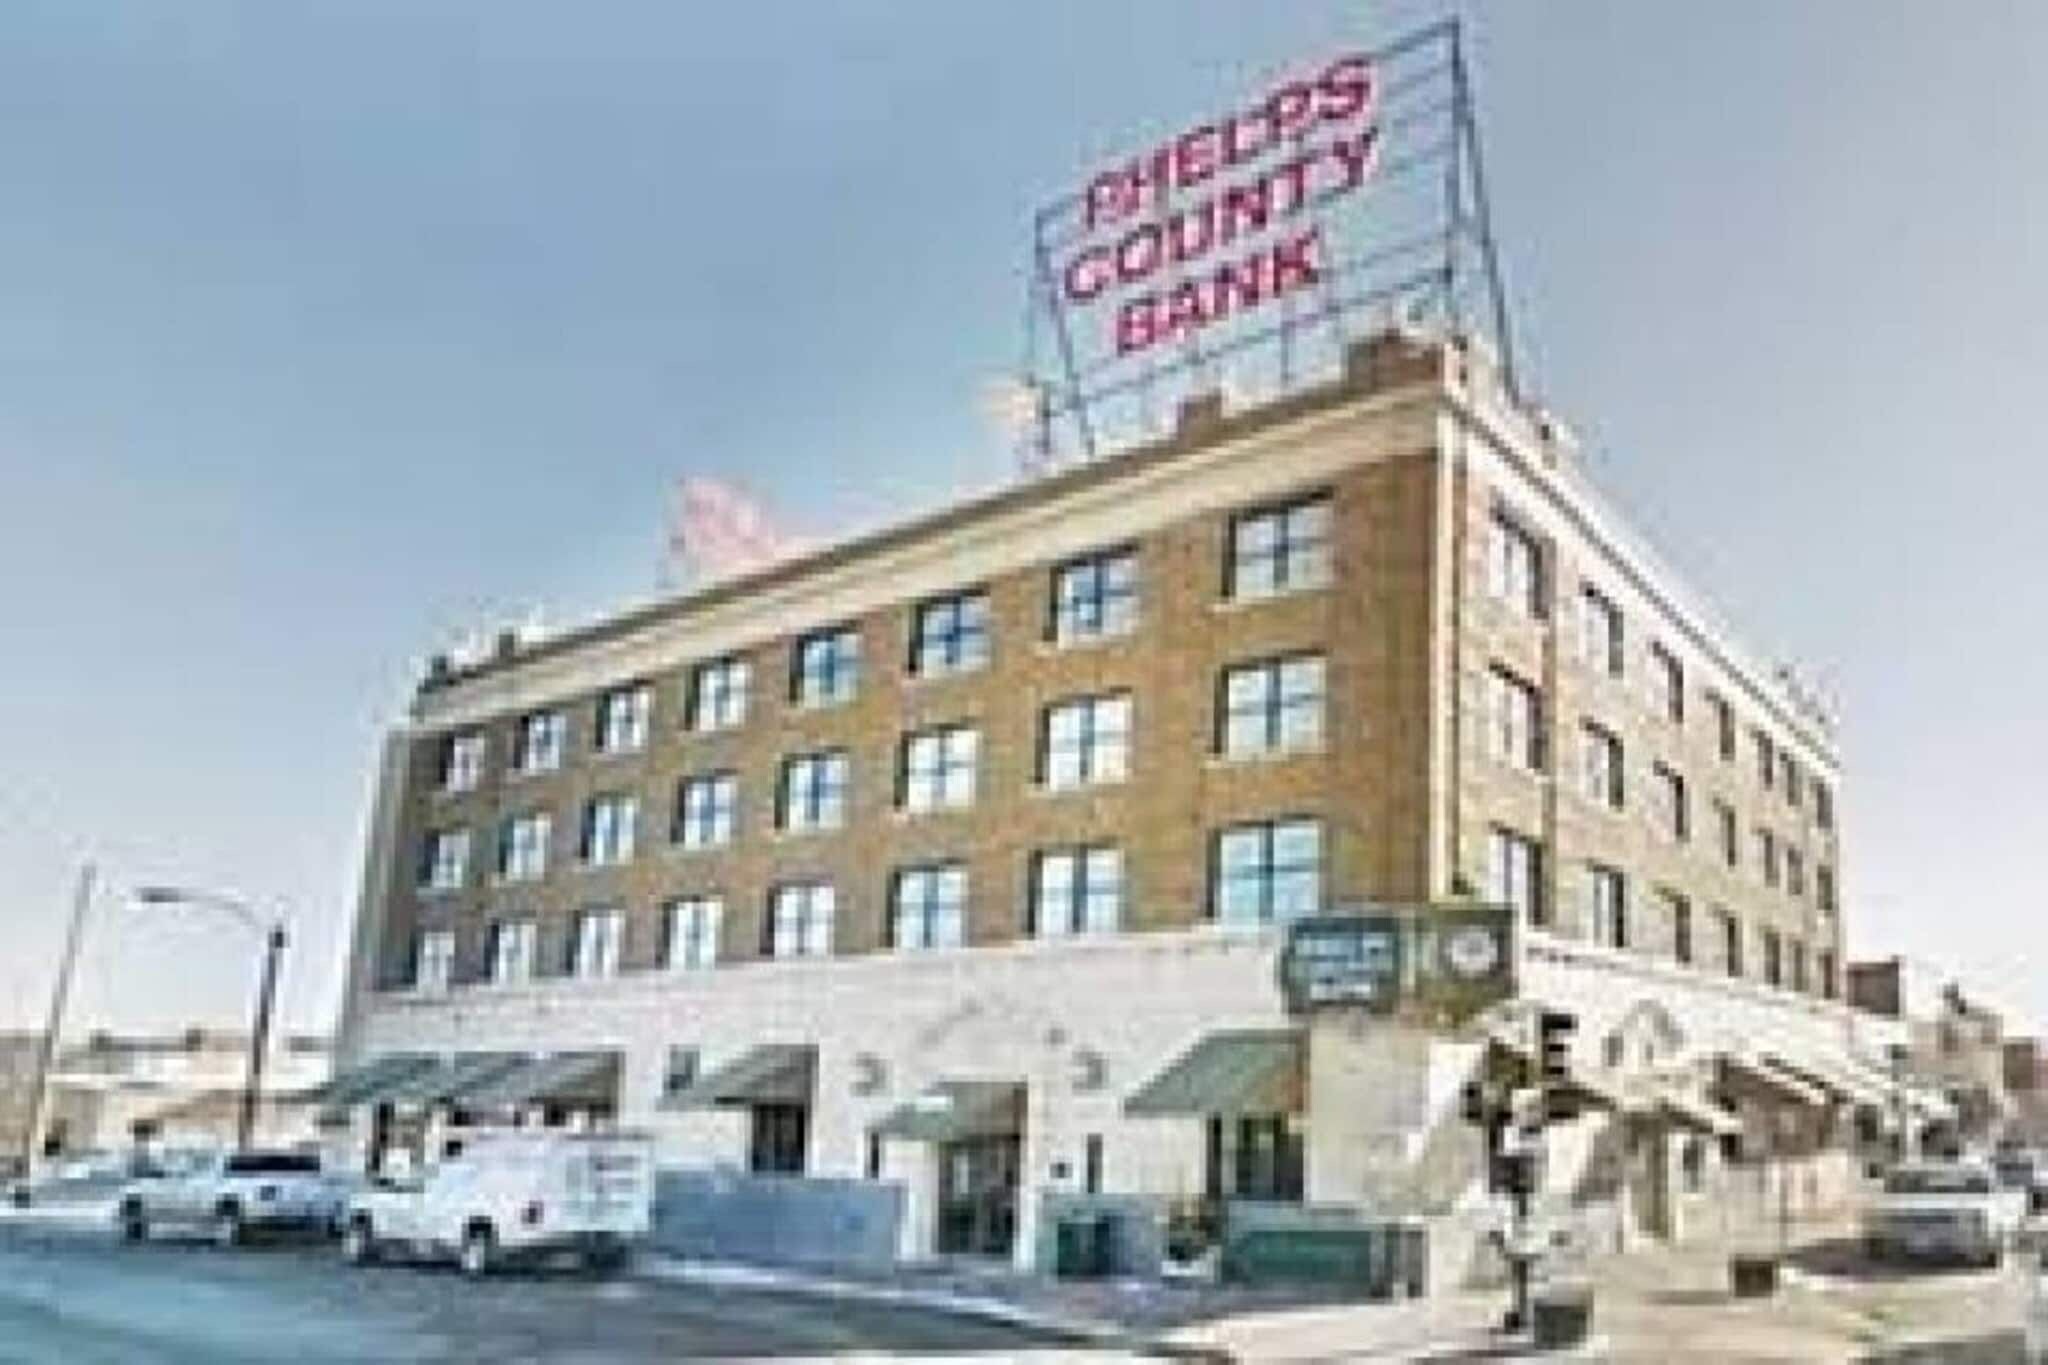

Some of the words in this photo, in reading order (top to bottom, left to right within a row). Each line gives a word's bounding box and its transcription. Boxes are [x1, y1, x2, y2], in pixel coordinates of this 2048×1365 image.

[1064, 125, 1379, 299] COUNTY
[1086, 57, 1373, 231] PHELPS
[1117, 223, 1321, 357] BANK
